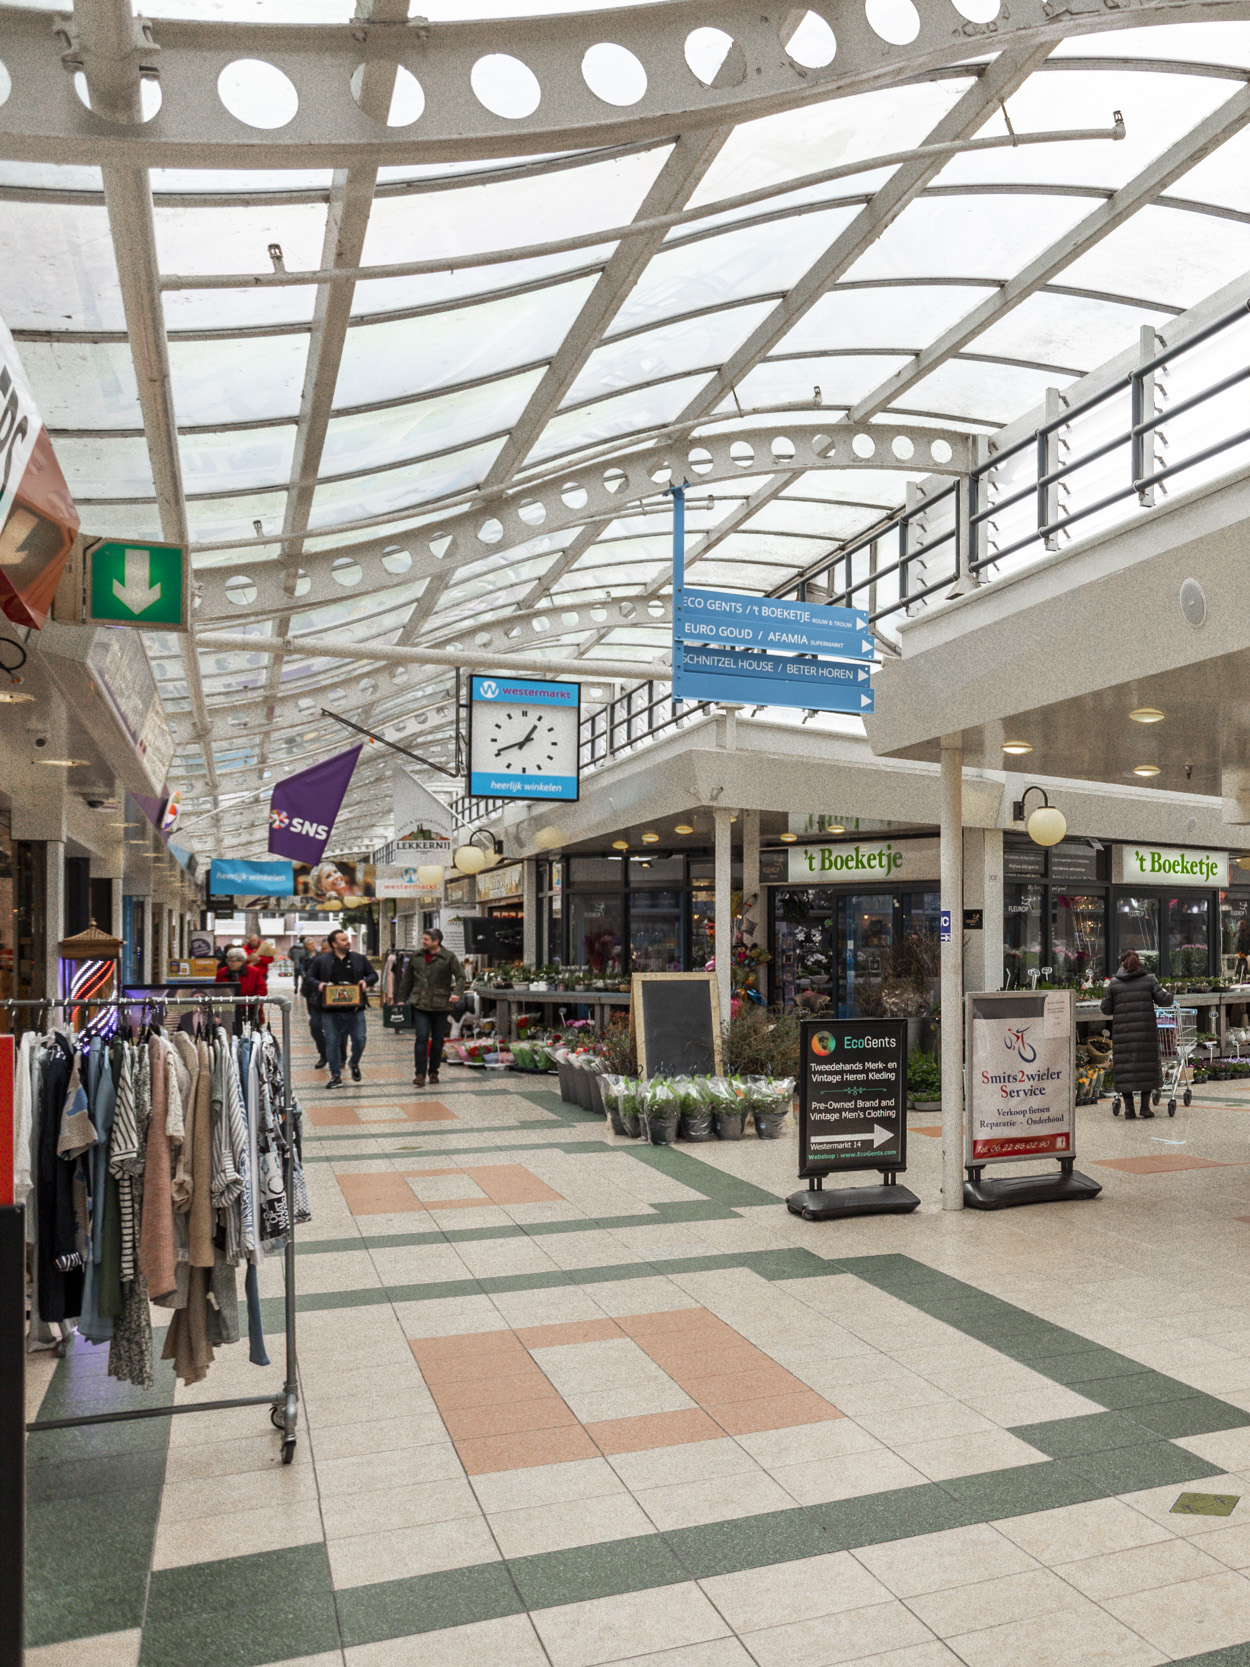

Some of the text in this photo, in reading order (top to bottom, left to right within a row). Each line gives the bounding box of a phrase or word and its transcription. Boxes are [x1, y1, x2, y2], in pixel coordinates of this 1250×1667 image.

[707, 599, 743, 614] GENTS
[762, 607, 811, 623] BOEKETJE
[684, 622, 716, 636] EURO
[719, 625, 753, 639] GOUD
[768, 632, 808, 645] AFAMIA
[810, 640, 844, 648] SUPERMARKT
[738, 658, 774, 672] HOUSE
[786, 664, 817, 677] BETER
[818, 666, 854, 680] HOREN
[502, 687, 571, 699] westermarkt
[490, 781, 562, 792] heerlijk winkelen
[290, 817, 329, 840] SNS
[396, 841, 450, 850] LEKKERNIJ
[819, 844, 903, 876] Boeketje
[1149, 851, 1218, 882] Boeketje
[844, 1035, 897, 1049] EcoGents
[810, 1062, 863, 1073] Tweedehands
[864, 1061, 886, 1070] Merk-
[811, 1071, 896, 1084] Vintage Heren Kleding
[981, 1067, 1062, 1085] Smits2wieler
[1000, 1084, 1046, 1099] Service
[811, 1098, 895, 1110] Pre-Owned Brand and
[810, 1108, 896, 1121] Vintage Men's Clothing
[997, 1106, 1050, 1118] Verkoop fietsen
[979, 1119, 1016, 1129] Reparatie
[1026, 1114, 1064, 1126] Onderhoud
[810, 1141, 851, 1150] Westermarkt
[991, 1144, 1001, 1153] 06
[1004, 1143, 1013, 1151] 22
[1027, 1141, 1038, 1149] 02
[1039, 1140, 1050, 1148] 90
[808, 1152, 836, 1160] Webshop
[840, 1149, 897, 1158] www.EcoGents.com
